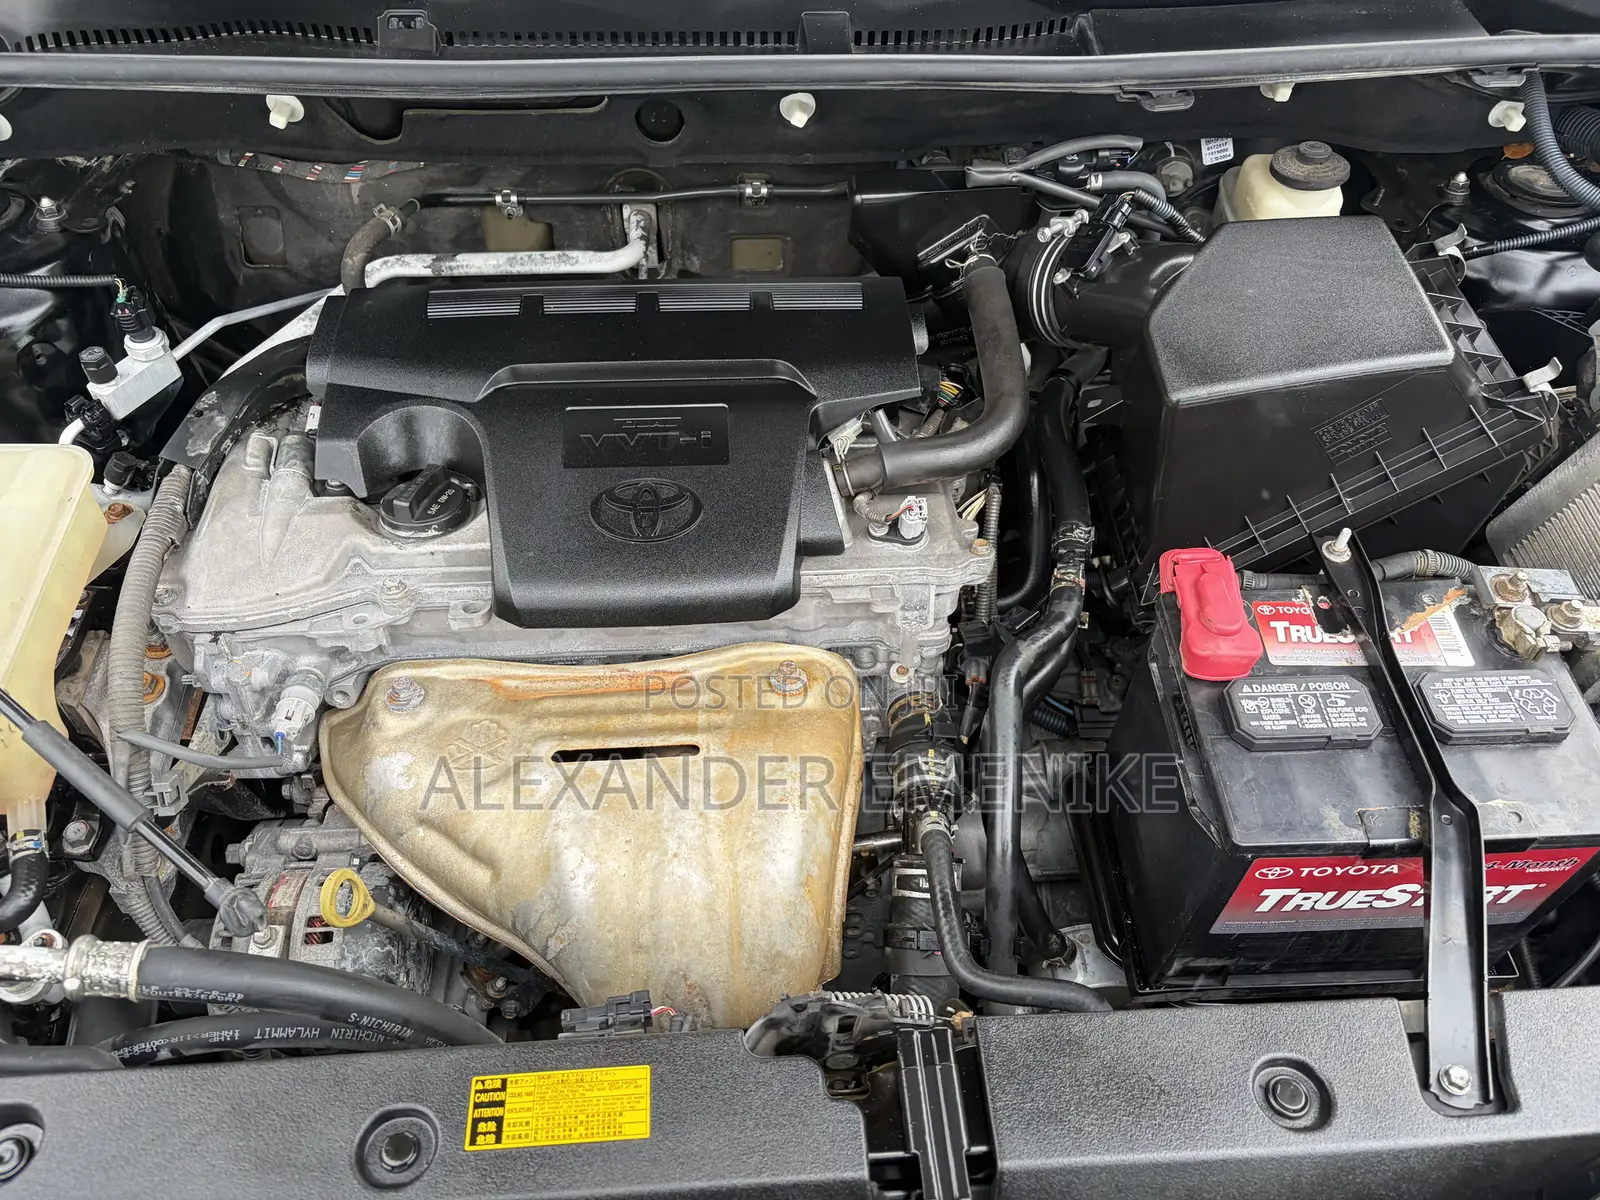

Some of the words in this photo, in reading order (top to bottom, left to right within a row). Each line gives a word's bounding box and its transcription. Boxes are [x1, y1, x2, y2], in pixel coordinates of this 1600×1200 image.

[427, 503, 441, 515] SAE
[1252, 683, 1298, 693] DANGER
[1308, 681, 1351, 691] POISON
[1299, 864, 1399, 878] TOYOTA
[474, 1091, 506, 1103] CAUTION
[472, 1107, 505, 1119] ATTENTION
